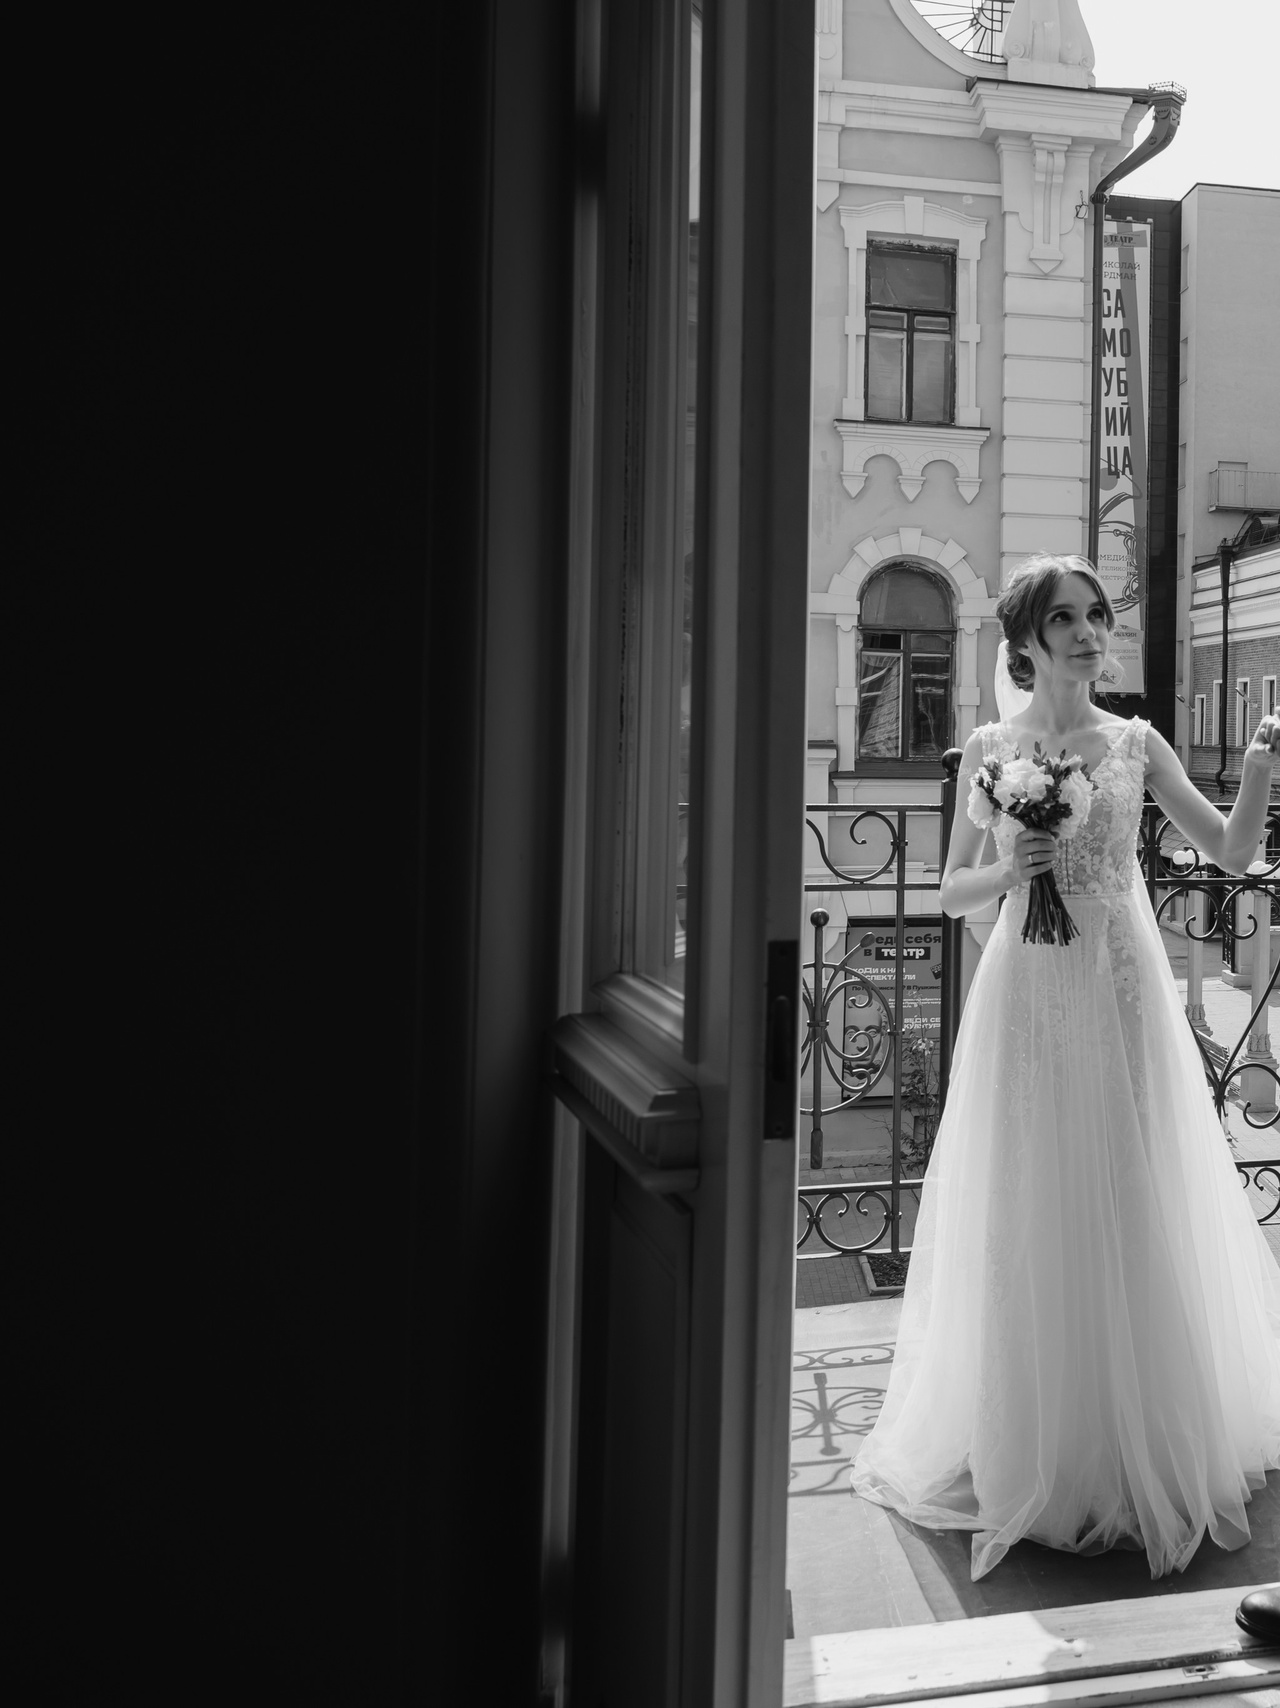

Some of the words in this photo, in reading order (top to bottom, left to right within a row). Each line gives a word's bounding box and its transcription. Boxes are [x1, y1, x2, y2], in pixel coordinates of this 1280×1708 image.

[1109, 235, 1134, 244] ТЕАТР
[1103, 261, 1140, 271] ИКОЛАЙ
[1103, 271, 1137, 280] РДМАН
[1102, 288, 1125, 318] СА
[1102, 328, 1131, 358] МО
[1101, 367, 1129, 397] УБ
[1105, 402, 1132, 437] ИЙ
[1106, 446, 1133, 479] ЦА
[905, 933, 942, 944] себя
[881, 947, 925, 959] тетр
